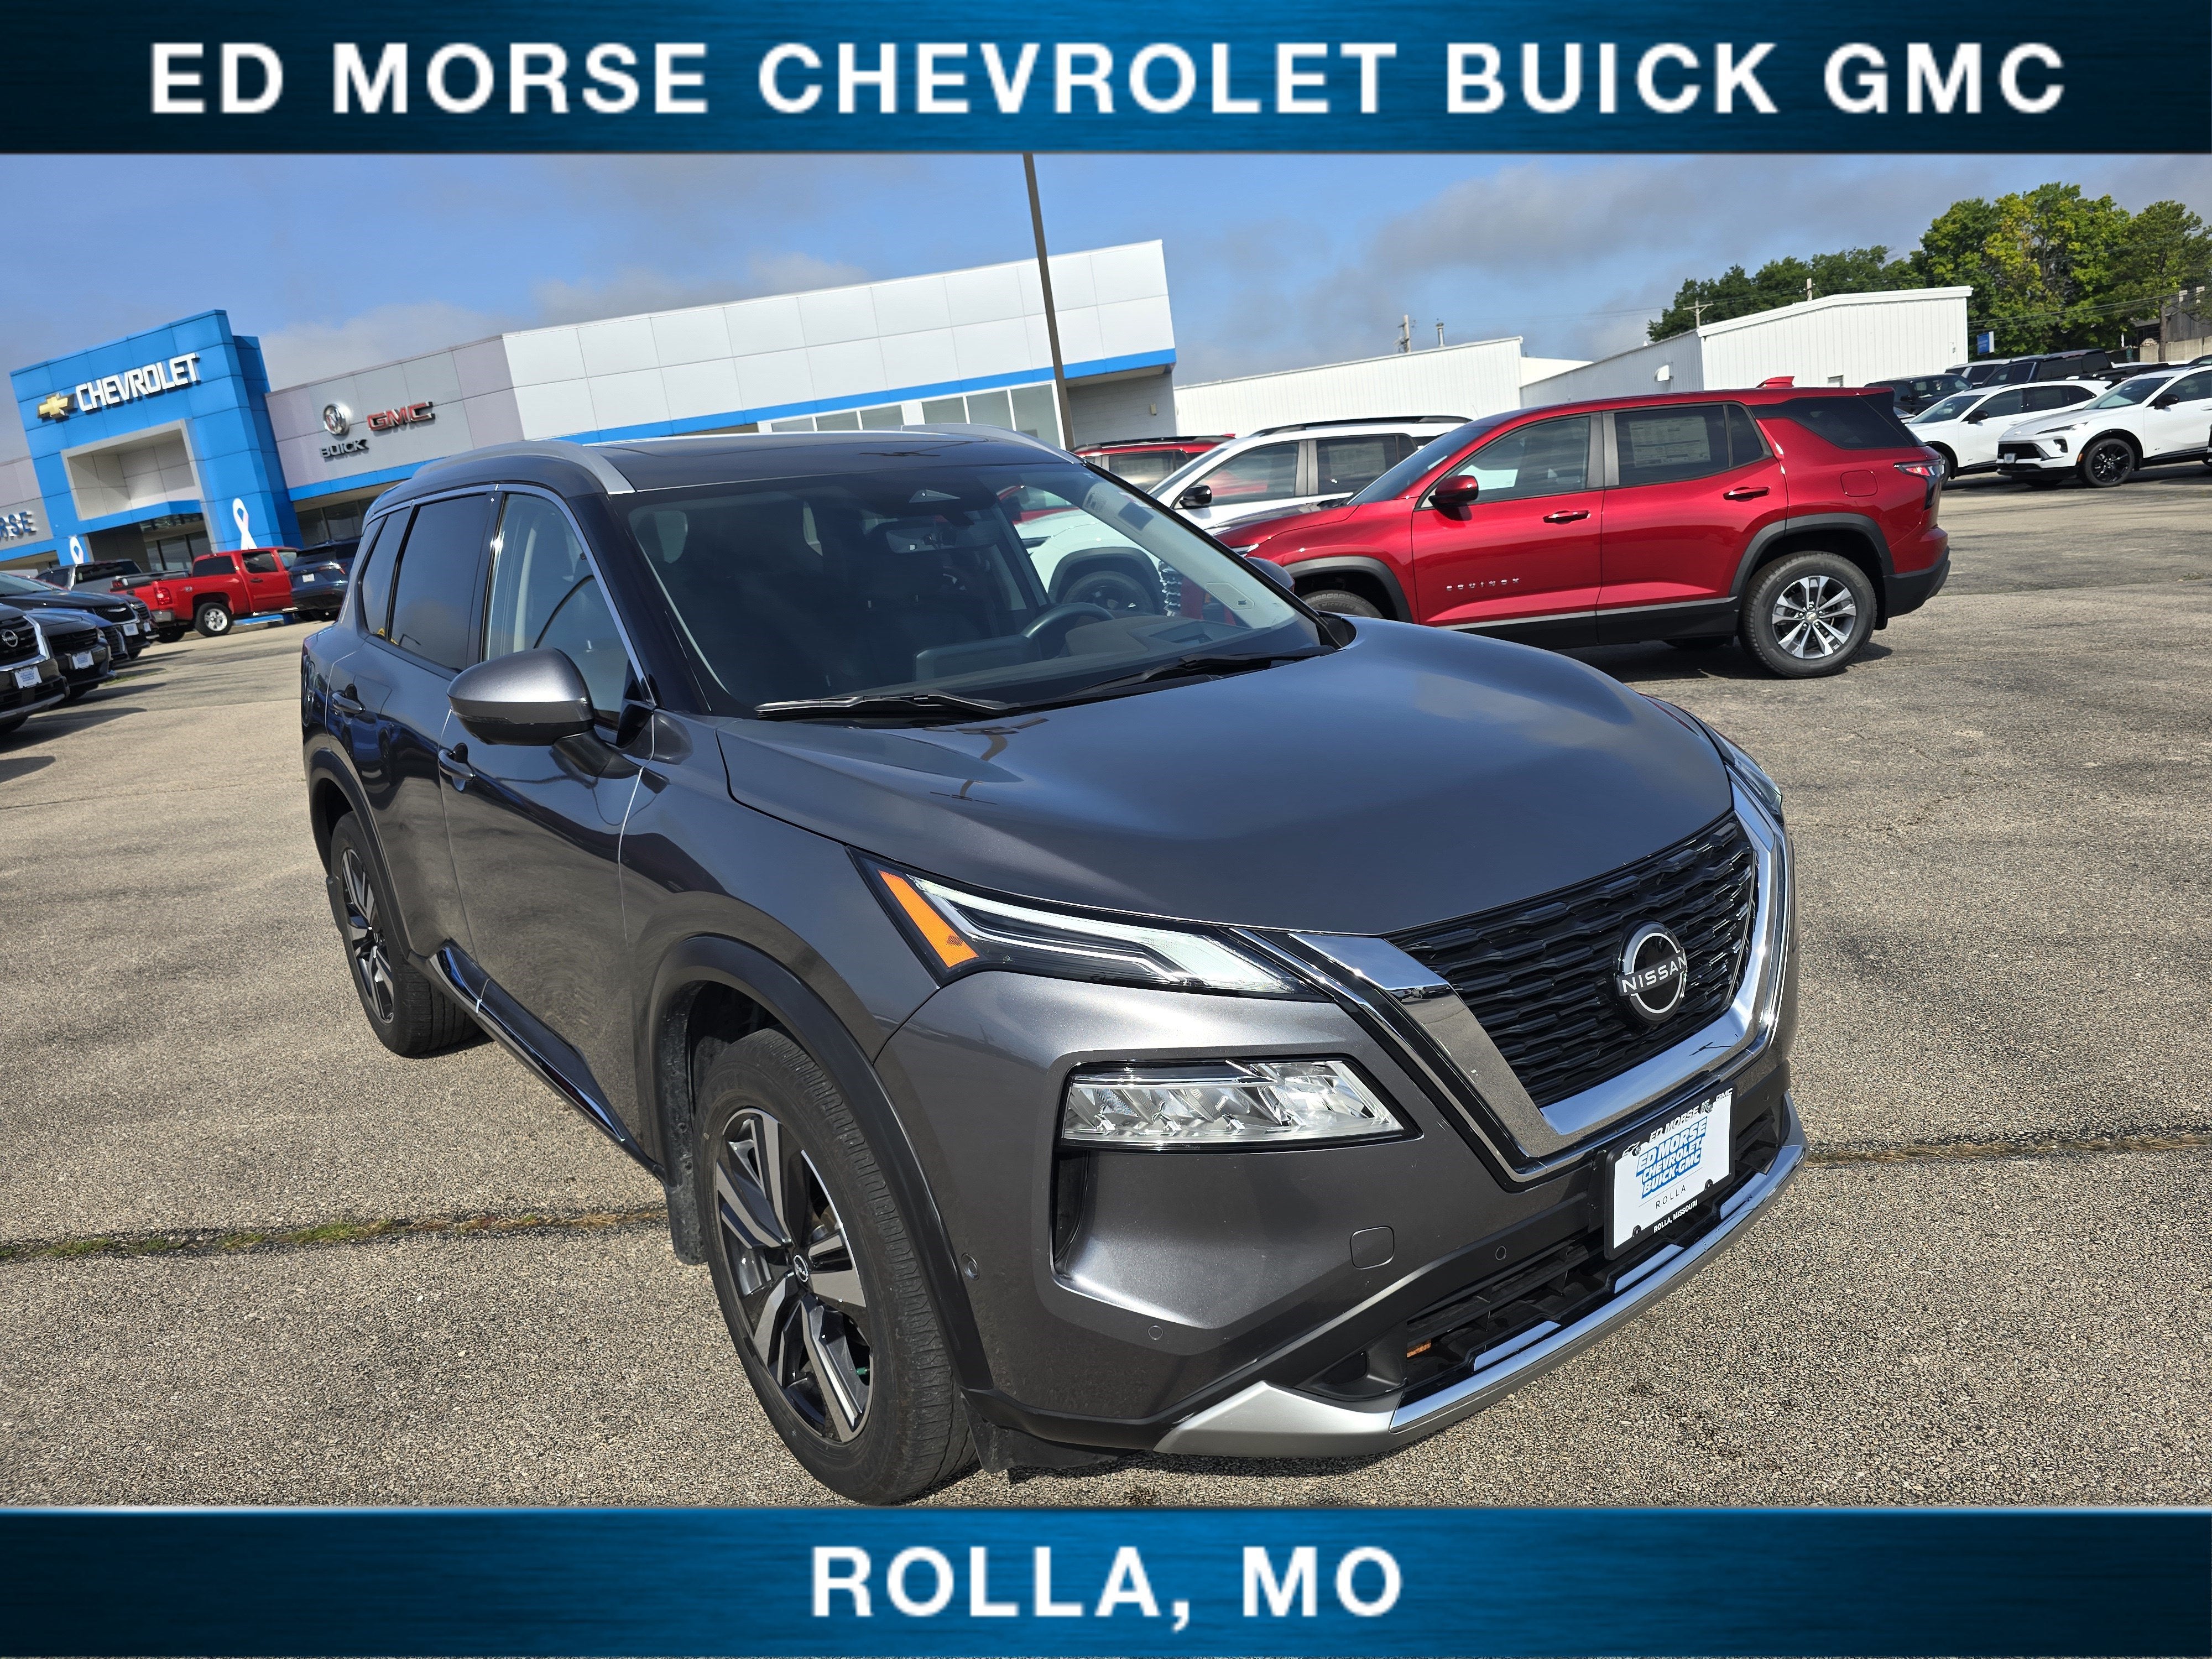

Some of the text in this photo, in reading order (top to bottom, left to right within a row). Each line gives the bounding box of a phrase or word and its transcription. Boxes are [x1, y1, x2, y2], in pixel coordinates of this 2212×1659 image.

[76, 352, 198, 411] CHEVROLET
[367, 401, 433, 431] GMC
[320, 440, 366, 457] BUICK
[1621, 953, 1687, 993] NISSAN
[1649, 1105, 1699, 1142] ED MORSE
[1636, 1117, 1708, 1173] ED MORSE
[1642, 1137, 1701, 1182] CHEVROLET
[1656, 1185, 1686, 1209] ROLLA
[1653, 1199, 1698, 1233] ROLLA, MISSOURI
